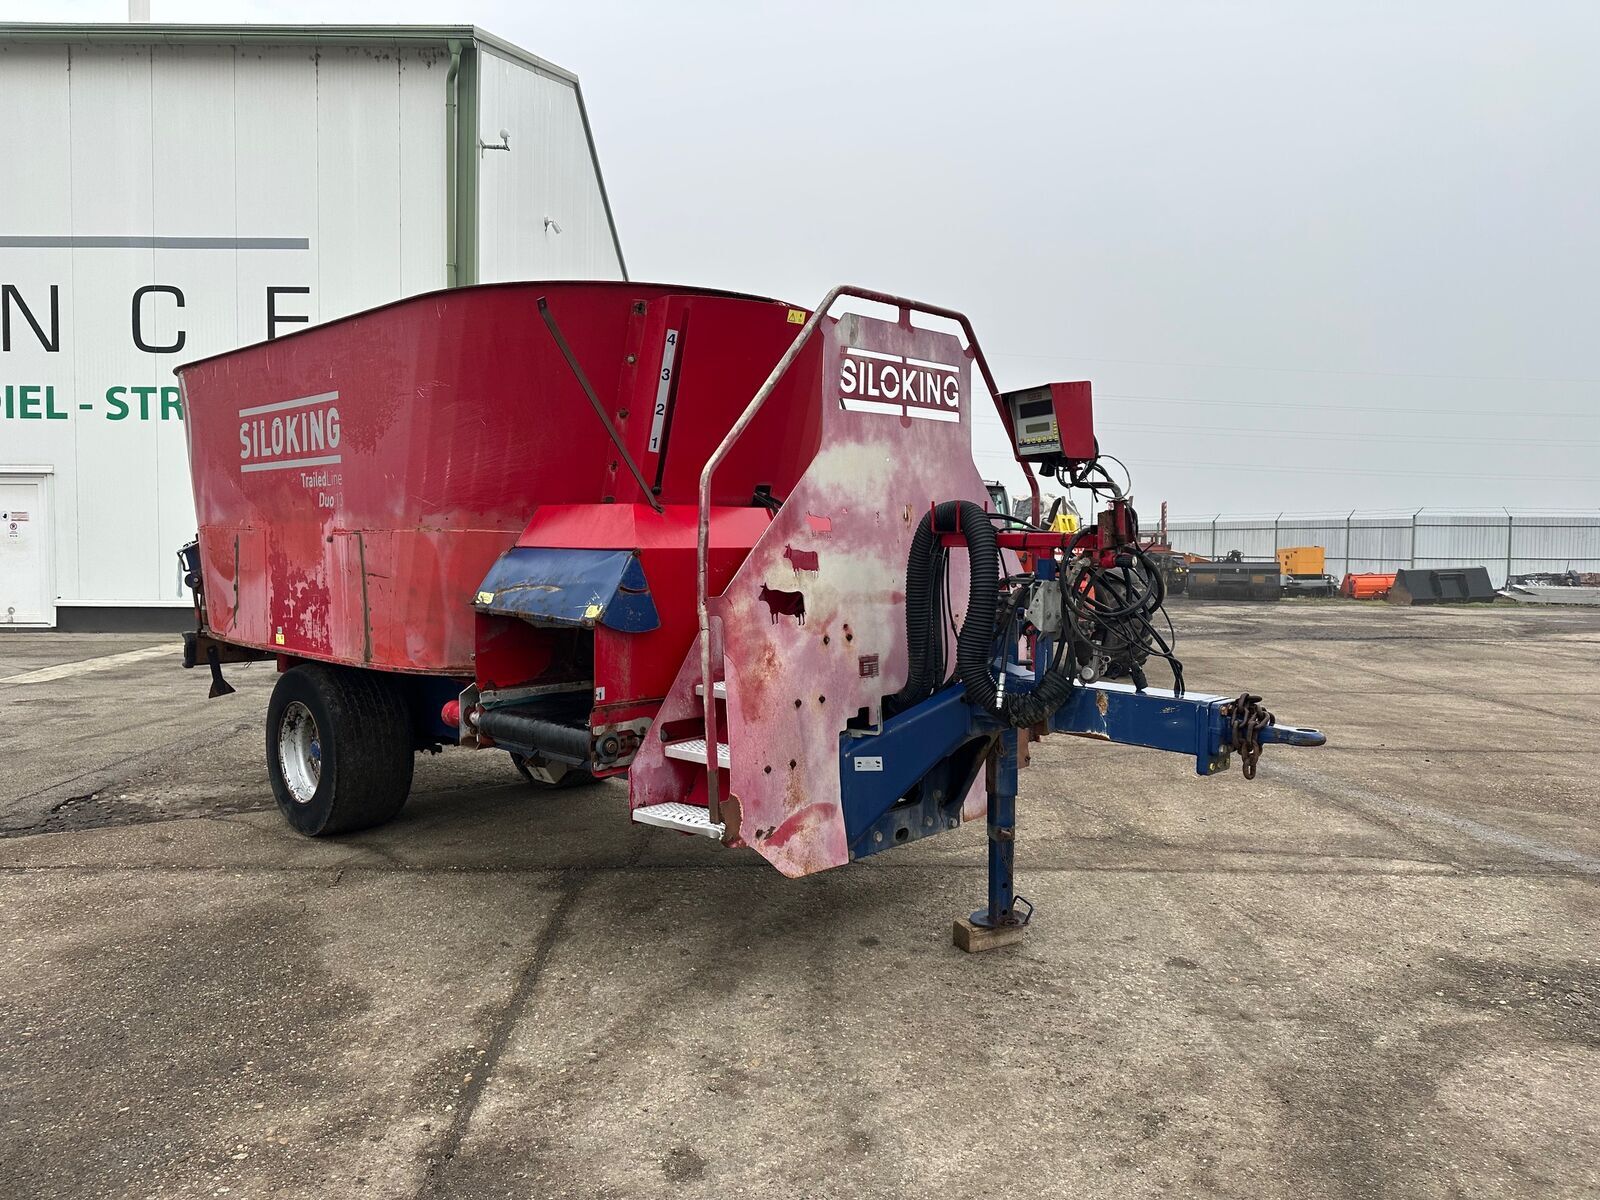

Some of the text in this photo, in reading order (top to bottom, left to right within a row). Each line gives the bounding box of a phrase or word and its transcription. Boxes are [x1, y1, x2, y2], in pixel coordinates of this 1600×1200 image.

[667, 333, 676, 346] 4
[661, 368, 671, 381] 3
[840, 358, 959, 408] SILOKING
[655, 403, 665, 416] 2
[239, 407, 340, 459] SILOKING
[651, 437, 658, 449] 1
[318, 492, 335, 508] Duo
